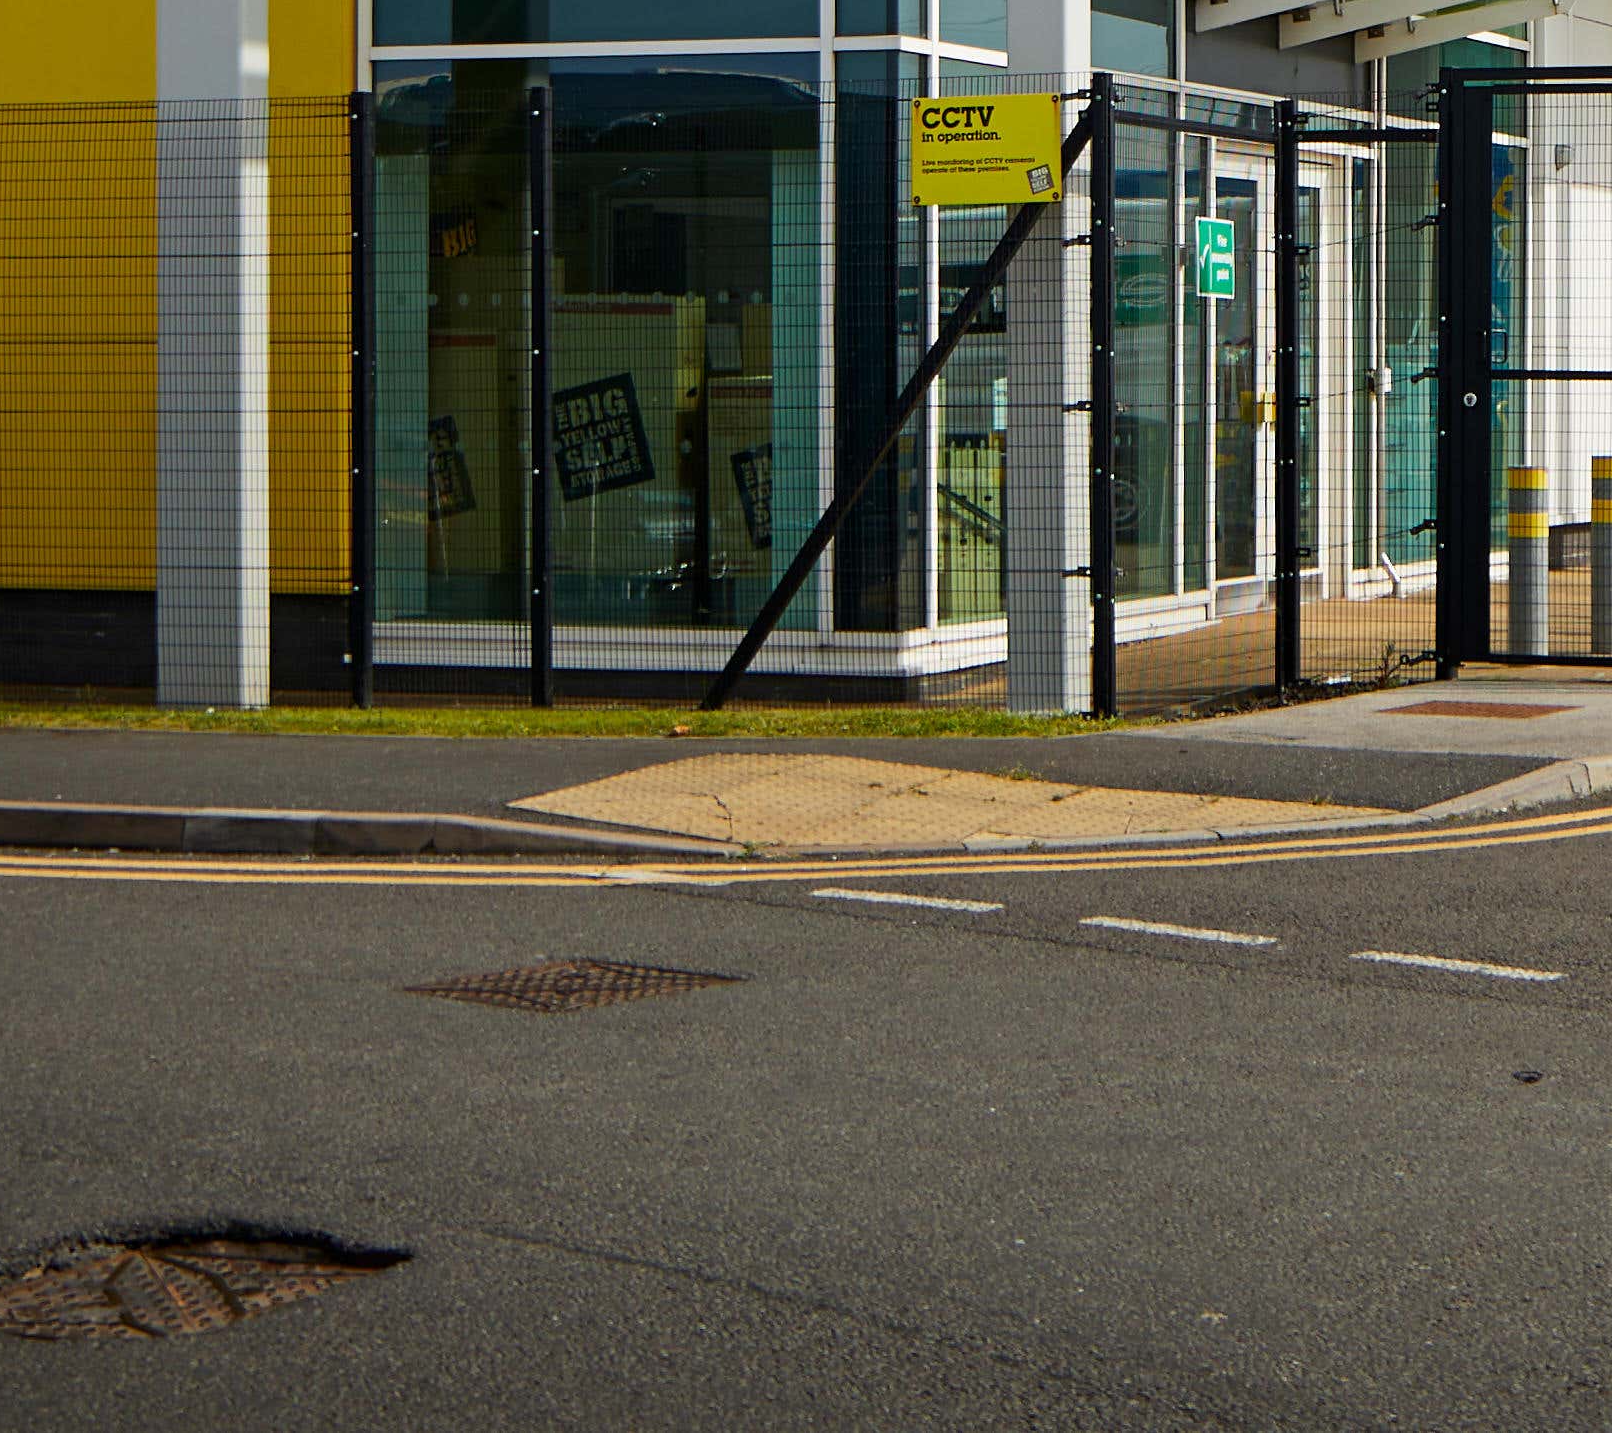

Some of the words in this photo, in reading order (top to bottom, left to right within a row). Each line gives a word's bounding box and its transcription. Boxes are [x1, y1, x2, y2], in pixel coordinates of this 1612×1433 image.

[922, 105, 994, 129] CCTV
[922, 131, 934, 143] in
[937, 130, 1002, 144] operation.
[567, 387, 629, 431] BIG
